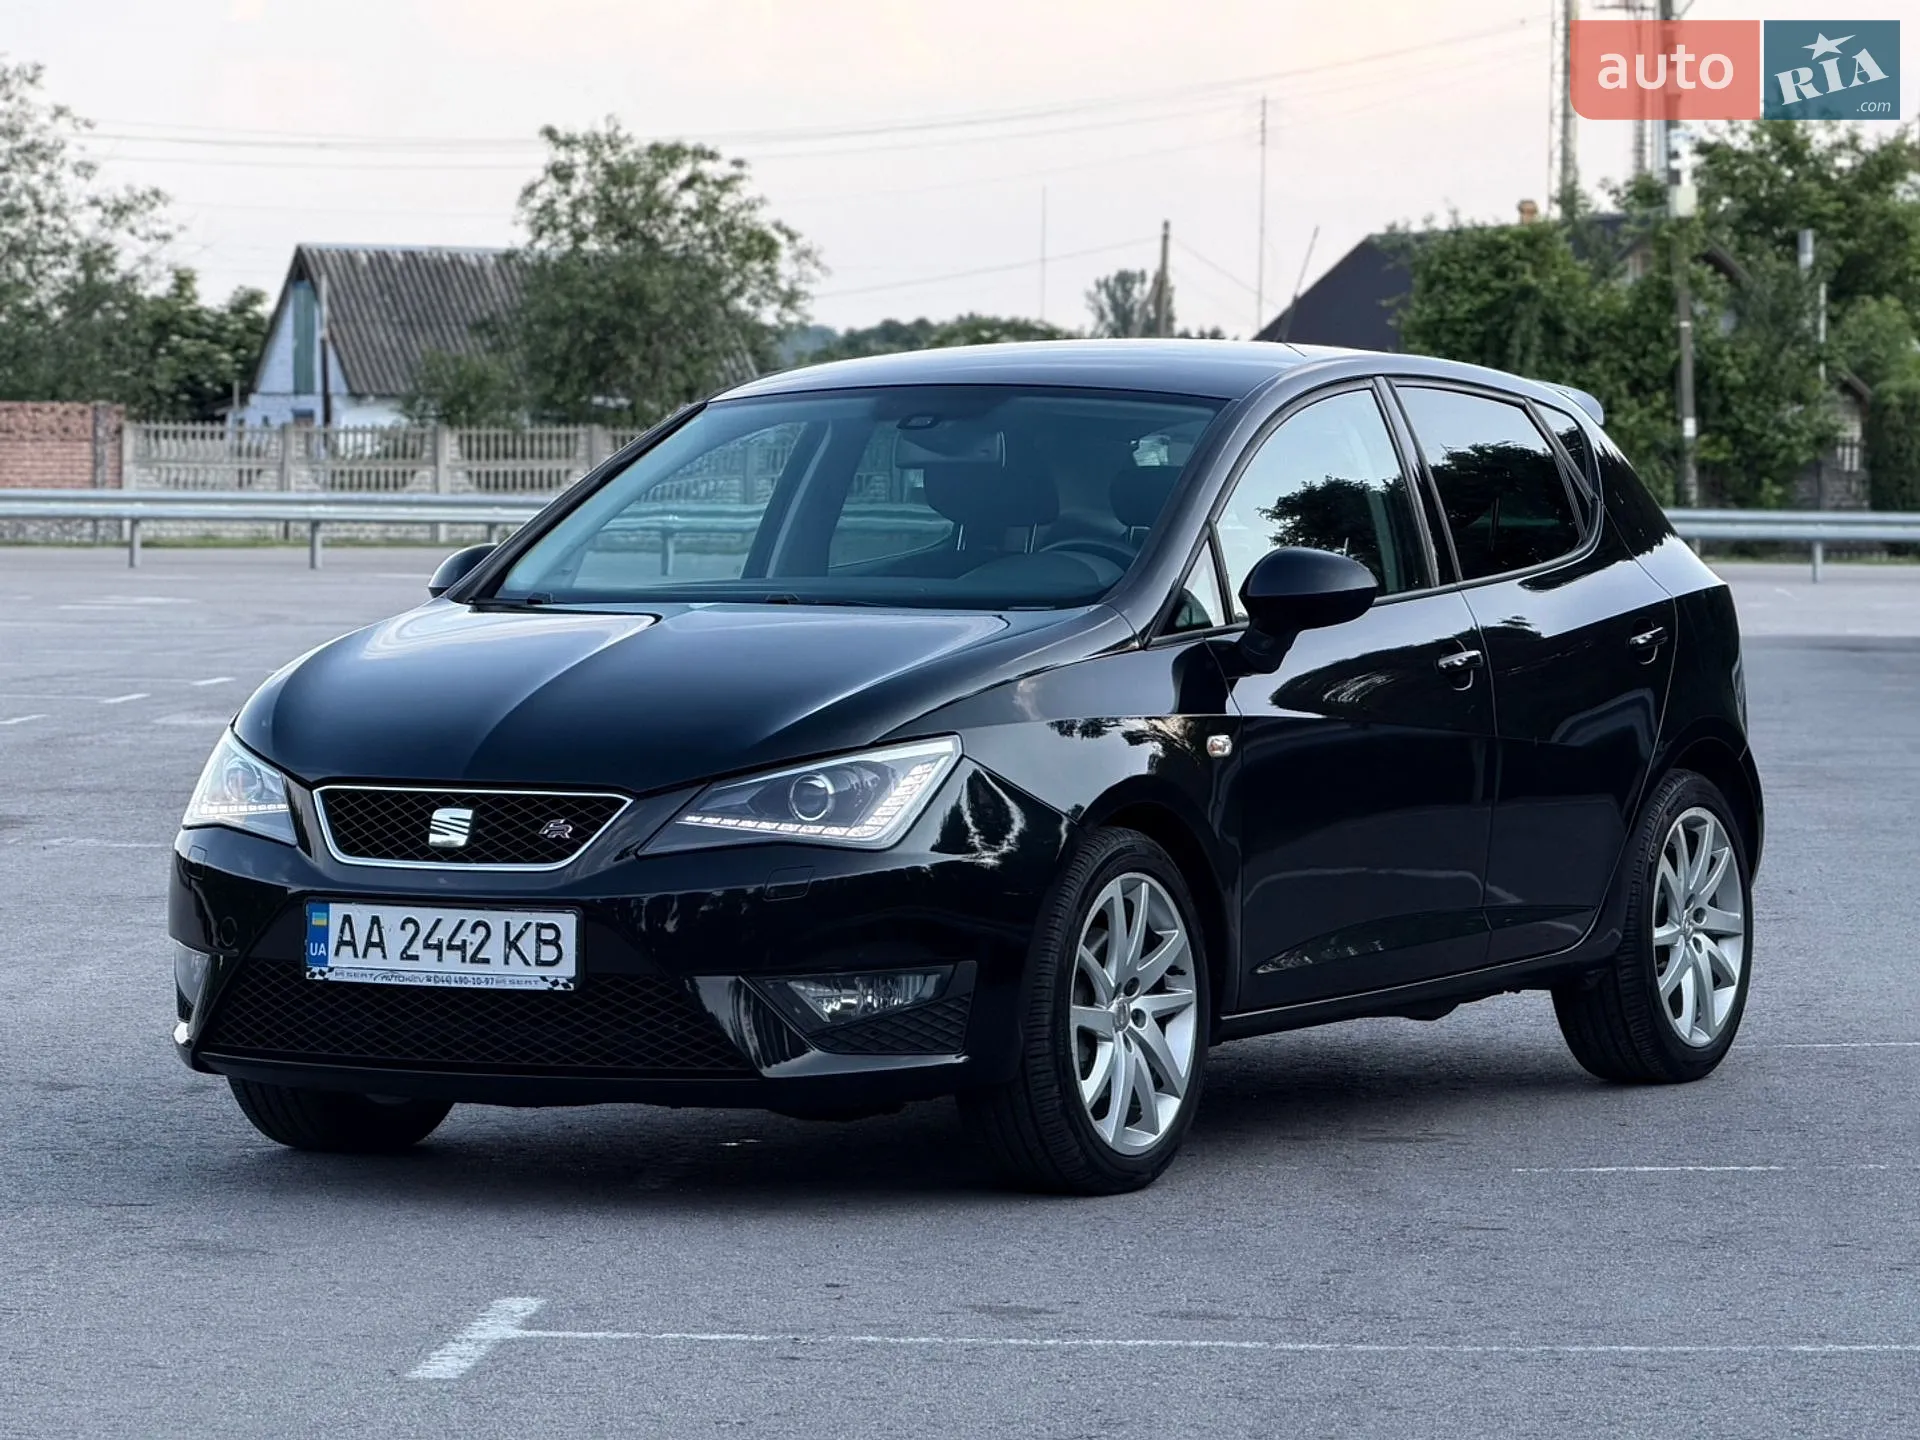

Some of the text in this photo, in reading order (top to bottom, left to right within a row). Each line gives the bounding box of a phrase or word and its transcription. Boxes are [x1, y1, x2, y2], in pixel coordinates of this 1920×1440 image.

[310, 942, 327, 957] UA
[334, 913, 564, 967] AA 2442 KB
